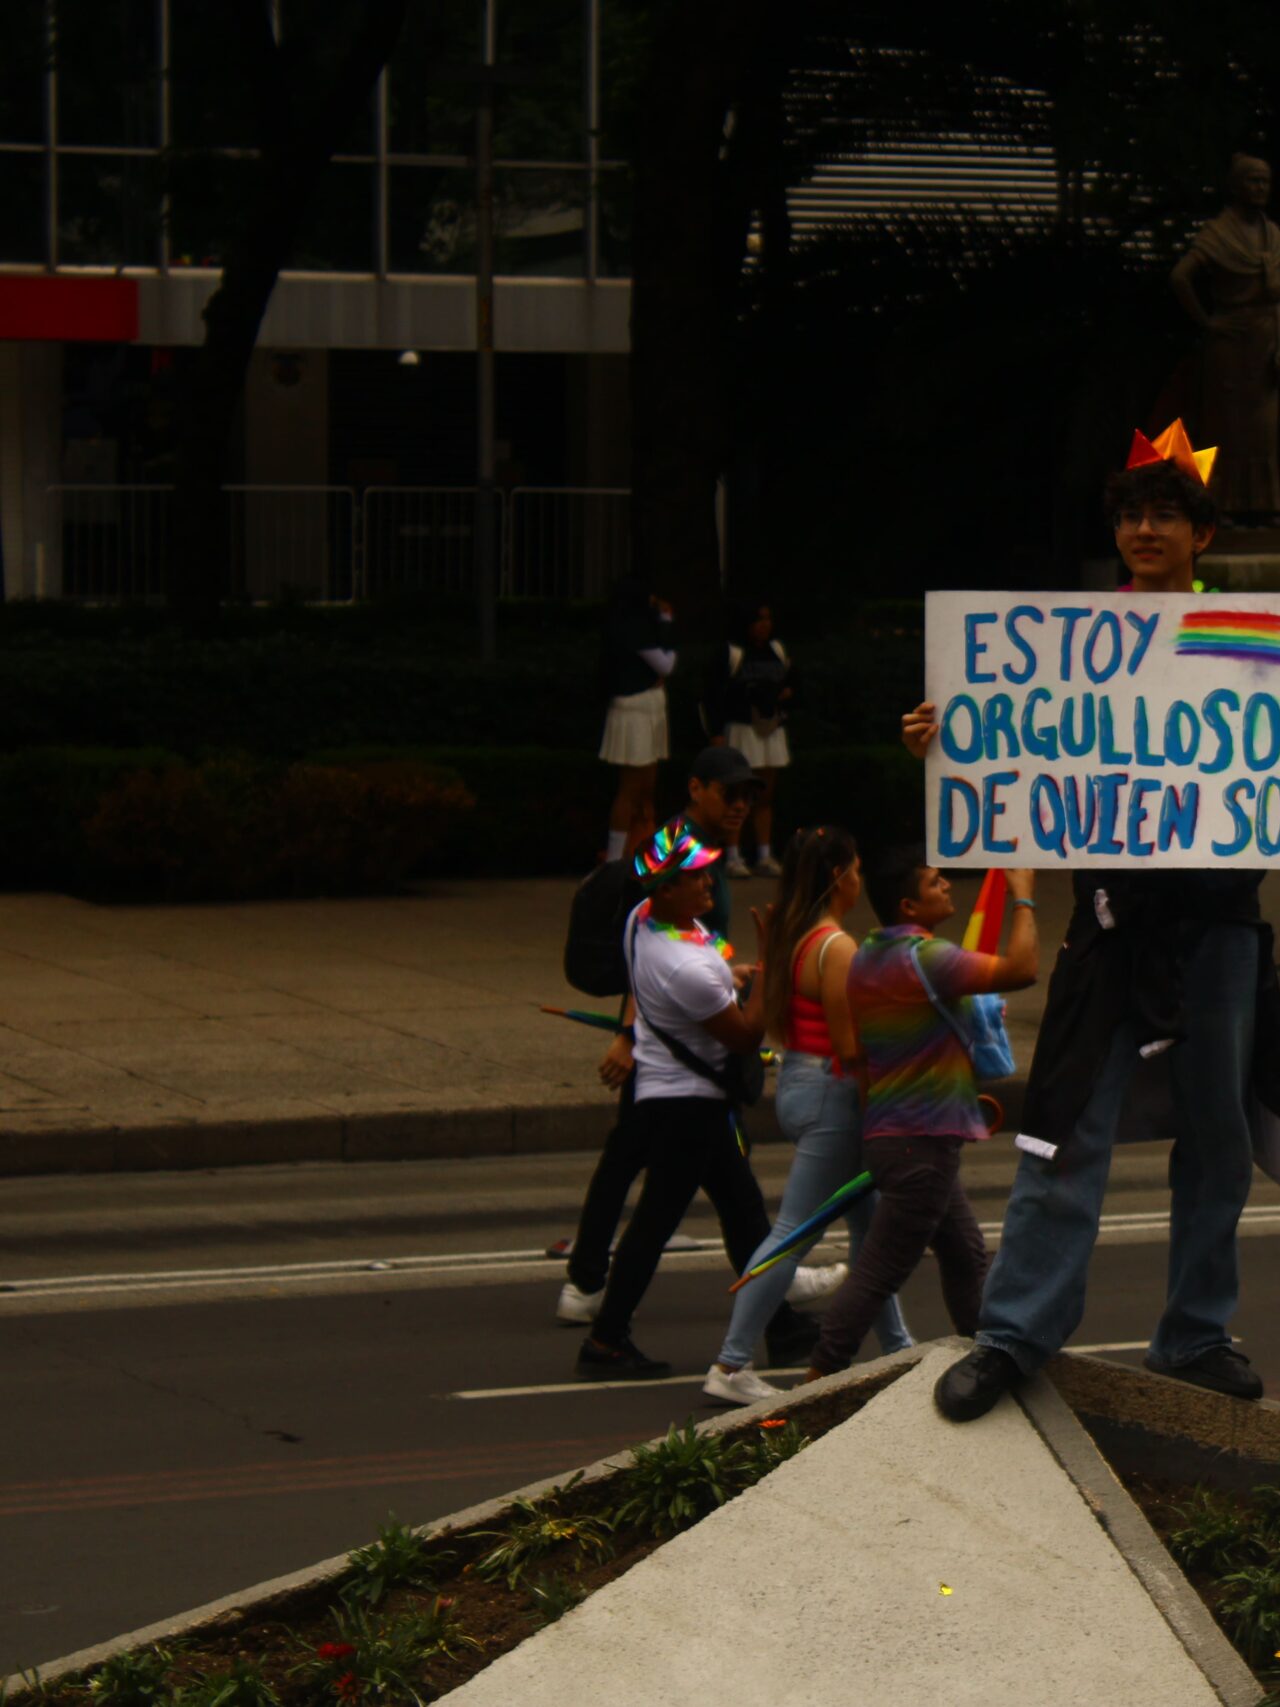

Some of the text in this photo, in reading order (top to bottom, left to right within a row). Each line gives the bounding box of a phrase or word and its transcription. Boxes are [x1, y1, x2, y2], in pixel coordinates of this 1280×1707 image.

[965, 605, 1160, 684] ESTOY
[937, 770, 1020, 857] DE
[1029, 772, 1200, 859] QUIEN
